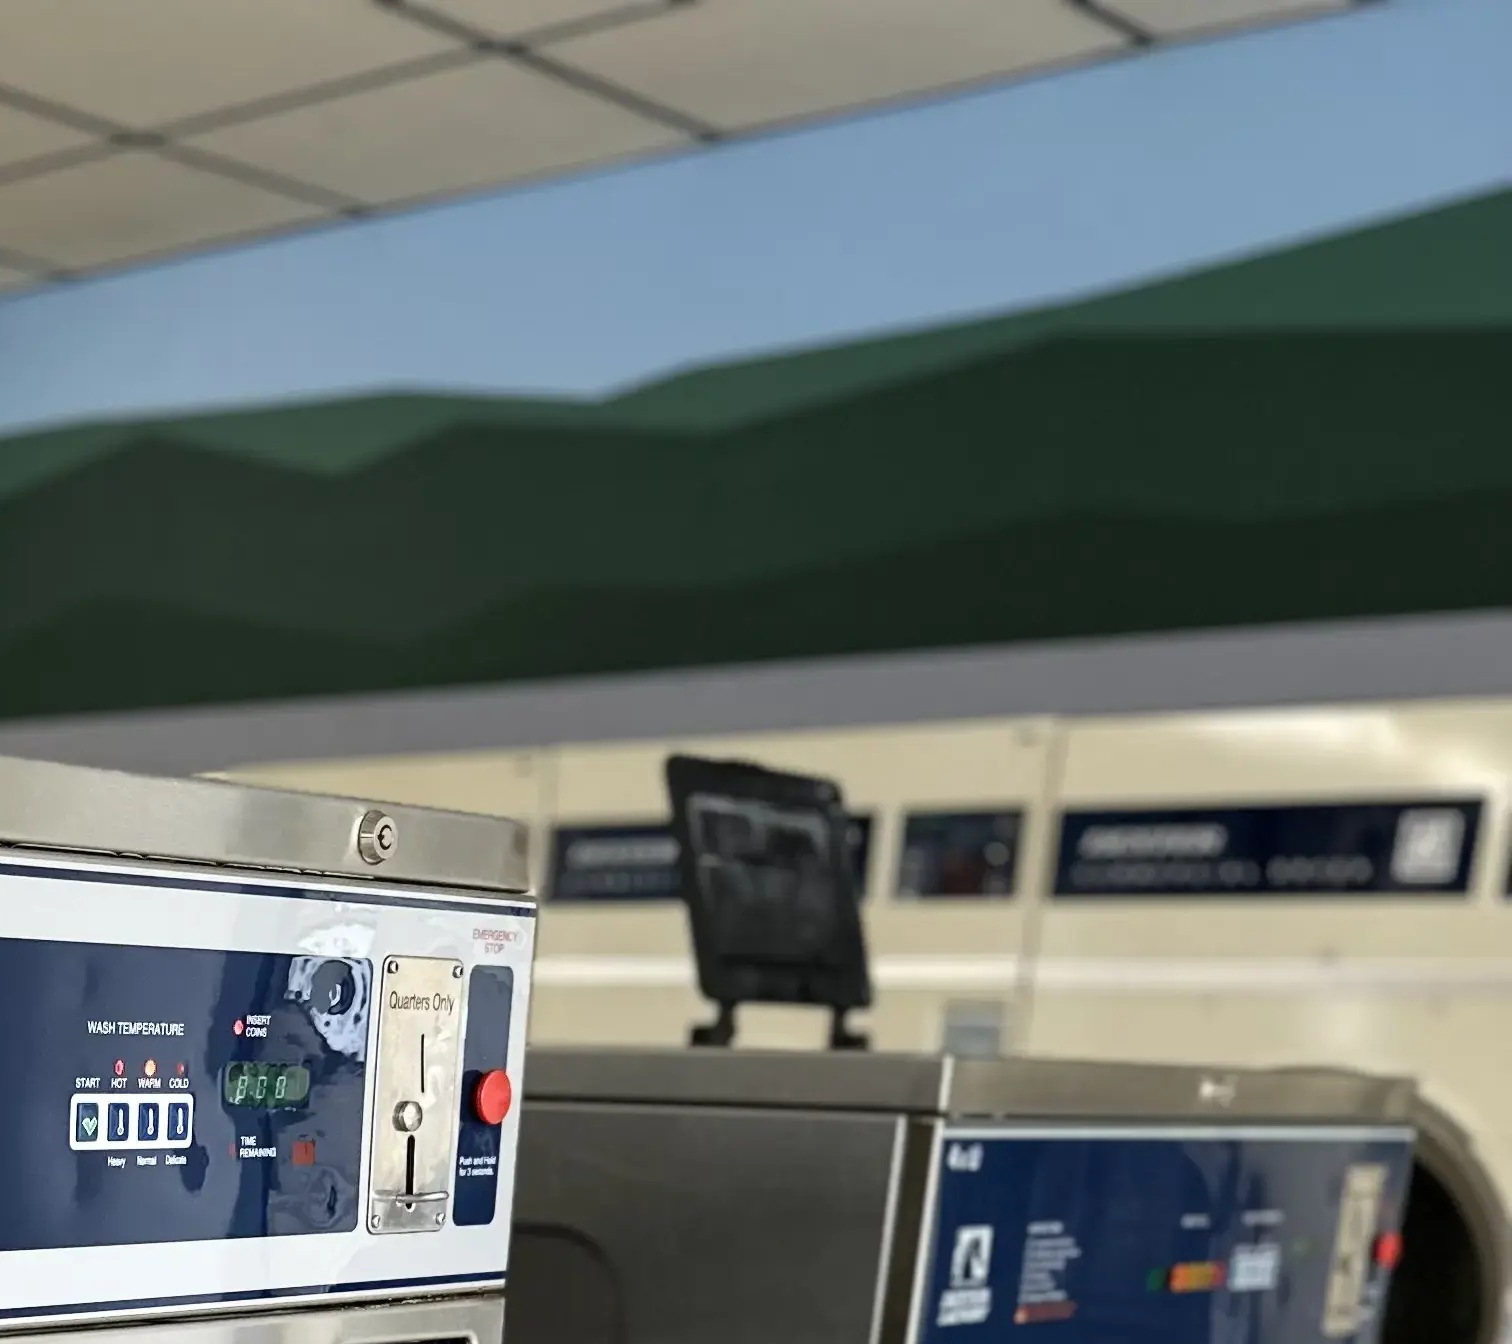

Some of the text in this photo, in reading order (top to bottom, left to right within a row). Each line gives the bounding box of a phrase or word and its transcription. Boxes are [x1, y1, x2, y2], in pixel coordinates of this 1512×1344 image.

[485, 943, 504, 953] STOP
[390, 991, 454, 1015] Quarters Only
[88, 1021, 184, 1035] WASH TEMPERATURE
[76, 1078, 100, 1088] START
[111, 1078, 127, 1088] HOT
[138, 1078, 161, 1088] WARM
[169, 1078, 189, 1088] COLD
[241, 1136, 256, 1145] TIME
